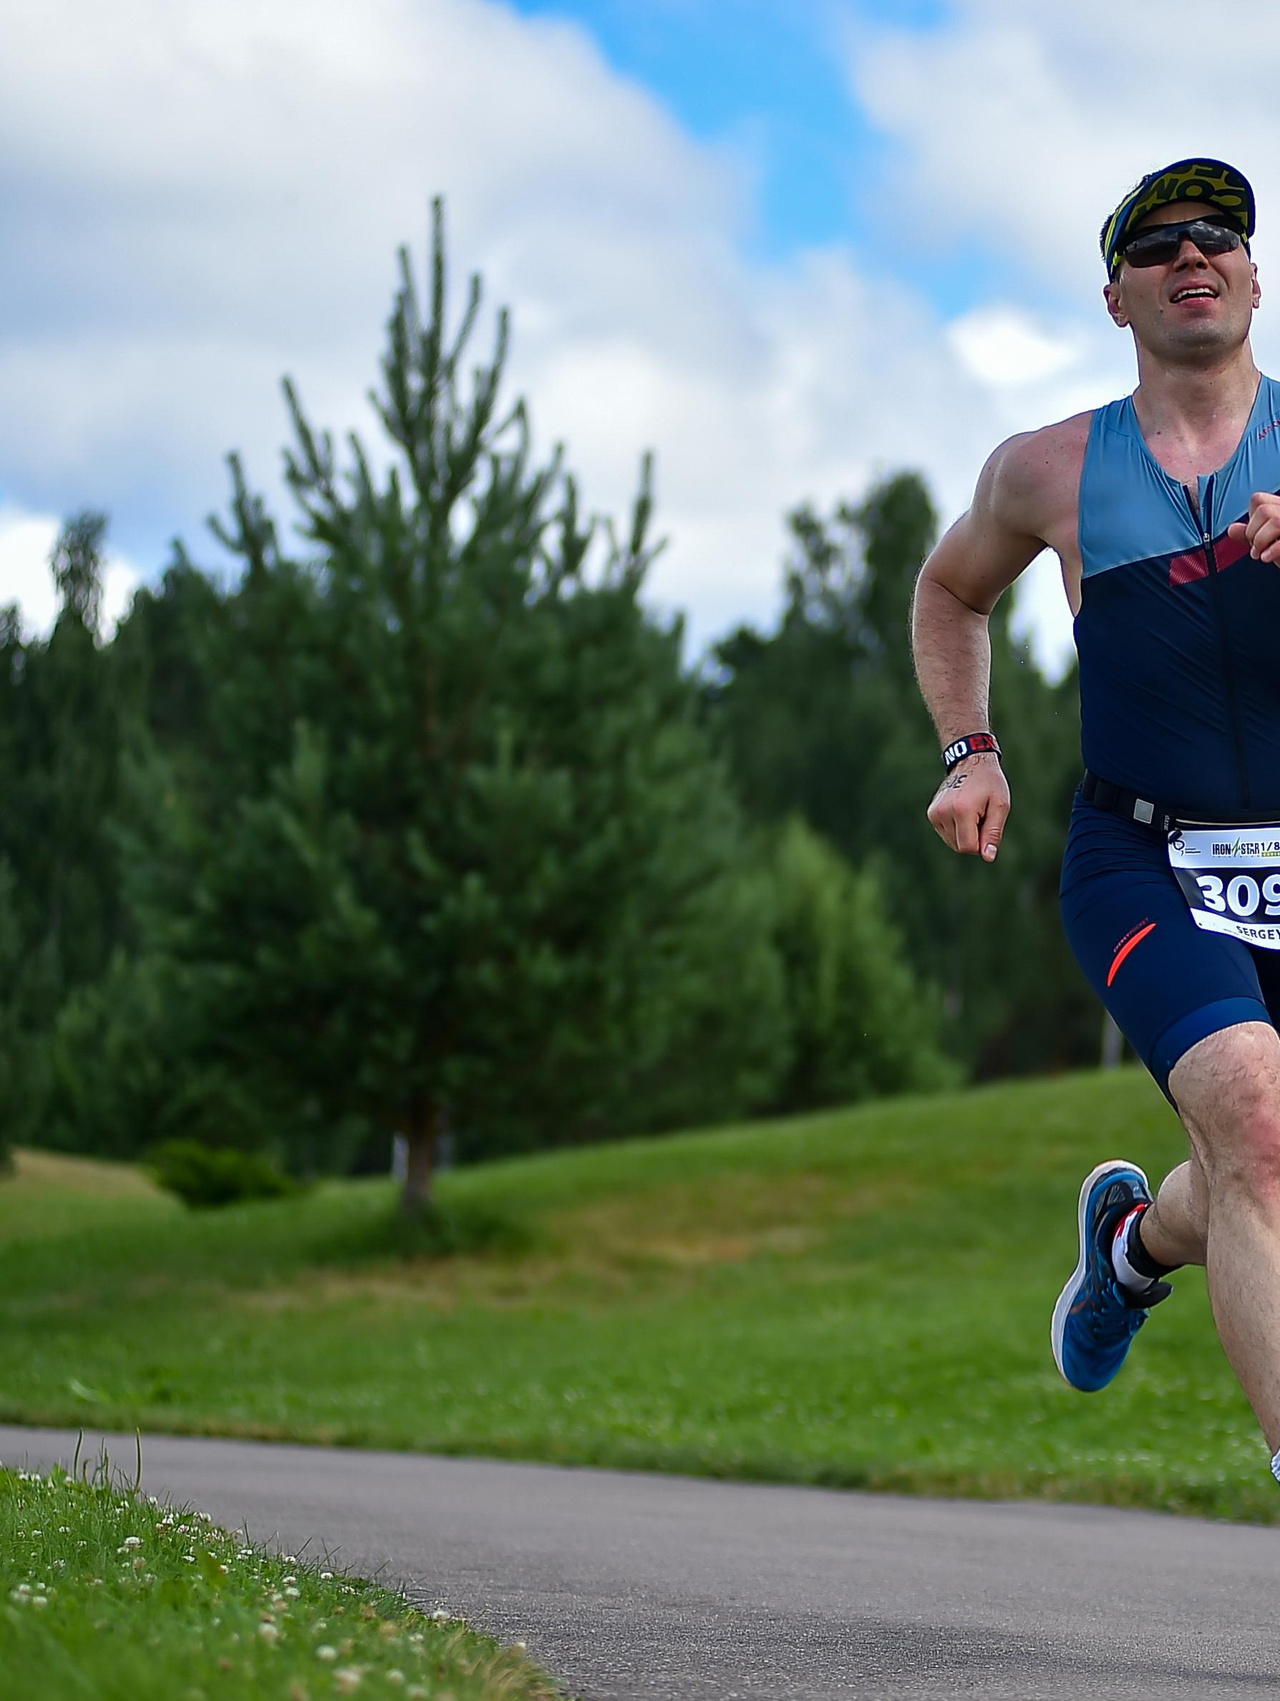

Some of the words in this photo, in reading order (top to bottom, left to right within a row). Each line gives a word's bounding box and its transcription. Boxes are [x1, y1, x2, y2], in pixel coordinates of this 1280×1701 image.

[945, 741, 968, 765] NO
[1212, 843, 1232, 856] IRON
[1261, 841, 1280, 851] 1/8
